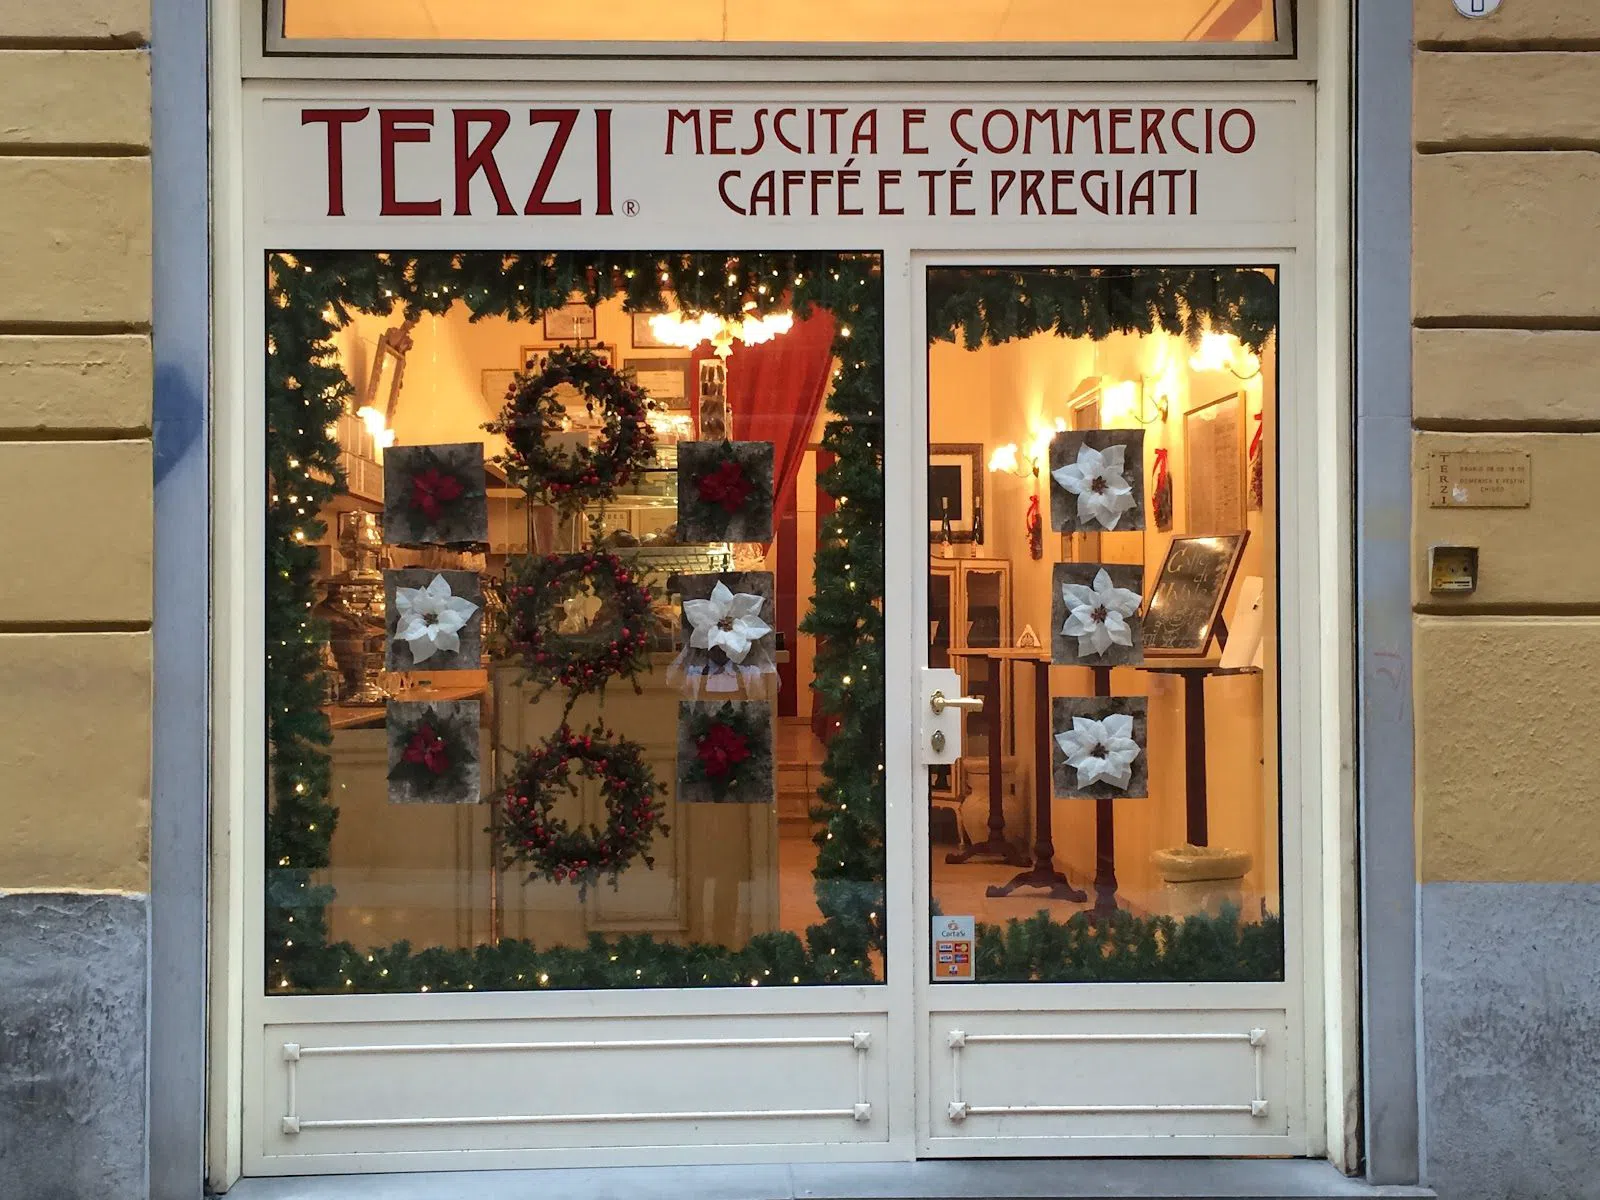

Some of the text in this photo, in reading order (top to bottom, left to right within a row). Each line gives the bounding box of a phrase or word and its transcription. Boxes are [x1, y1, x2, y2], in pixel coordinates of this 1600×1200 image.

[664, 108, 1256, 155] MESCITA E COMMERCIO
[301, 107, 613, 216] TERZI
[718, 158, 1198, 216] CAFFÉ E TÉ PREGIATI
[1439, 454, 1449, 504] TERZI
